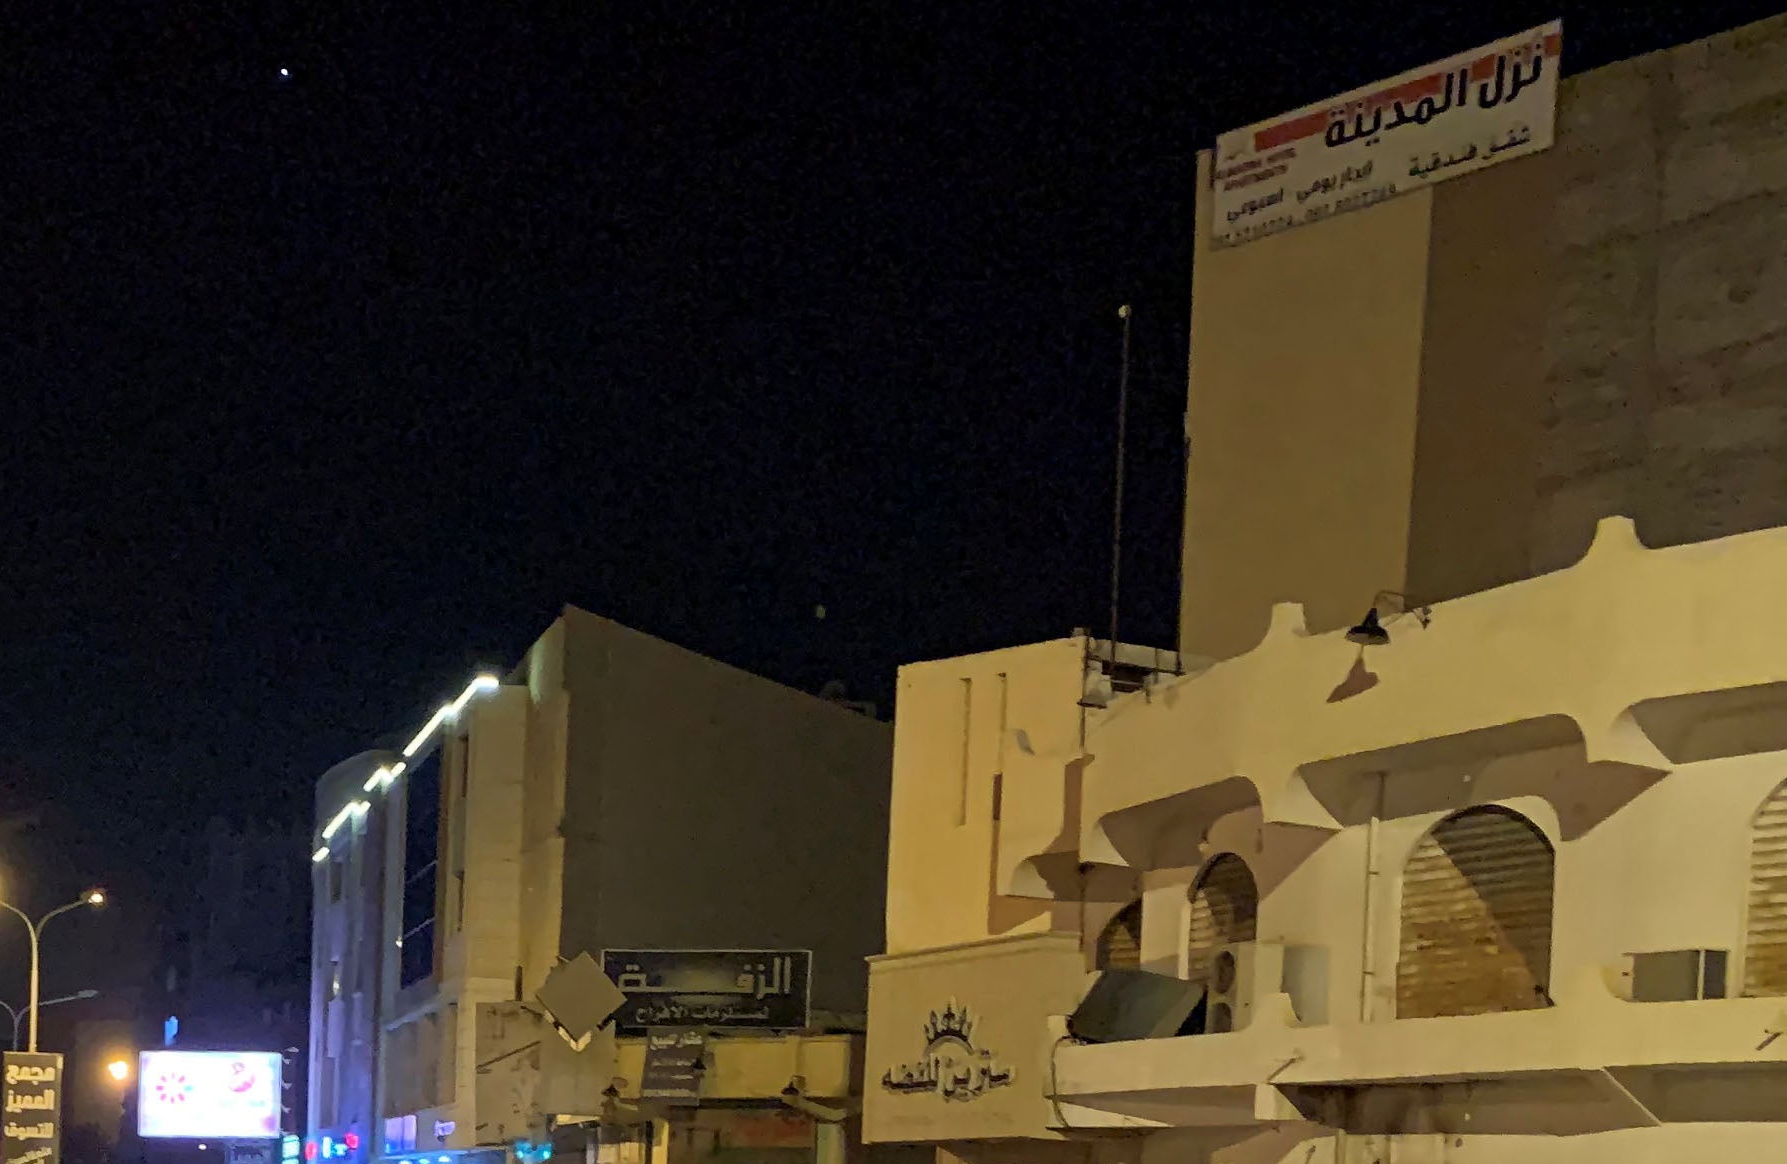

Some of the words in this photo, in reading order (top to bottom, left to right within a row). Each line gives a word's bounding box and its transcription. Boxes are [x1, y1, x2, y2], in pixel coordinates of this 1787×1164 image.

[1479, 43, 1542, 108] نزل
[1325, 68, 1468, 148] المدينة
[5, 1064, 56, 1085] مجمع
[4, 1088, 55, 1113] المميز
[3, 1121, 54, 1141] للتسوق
